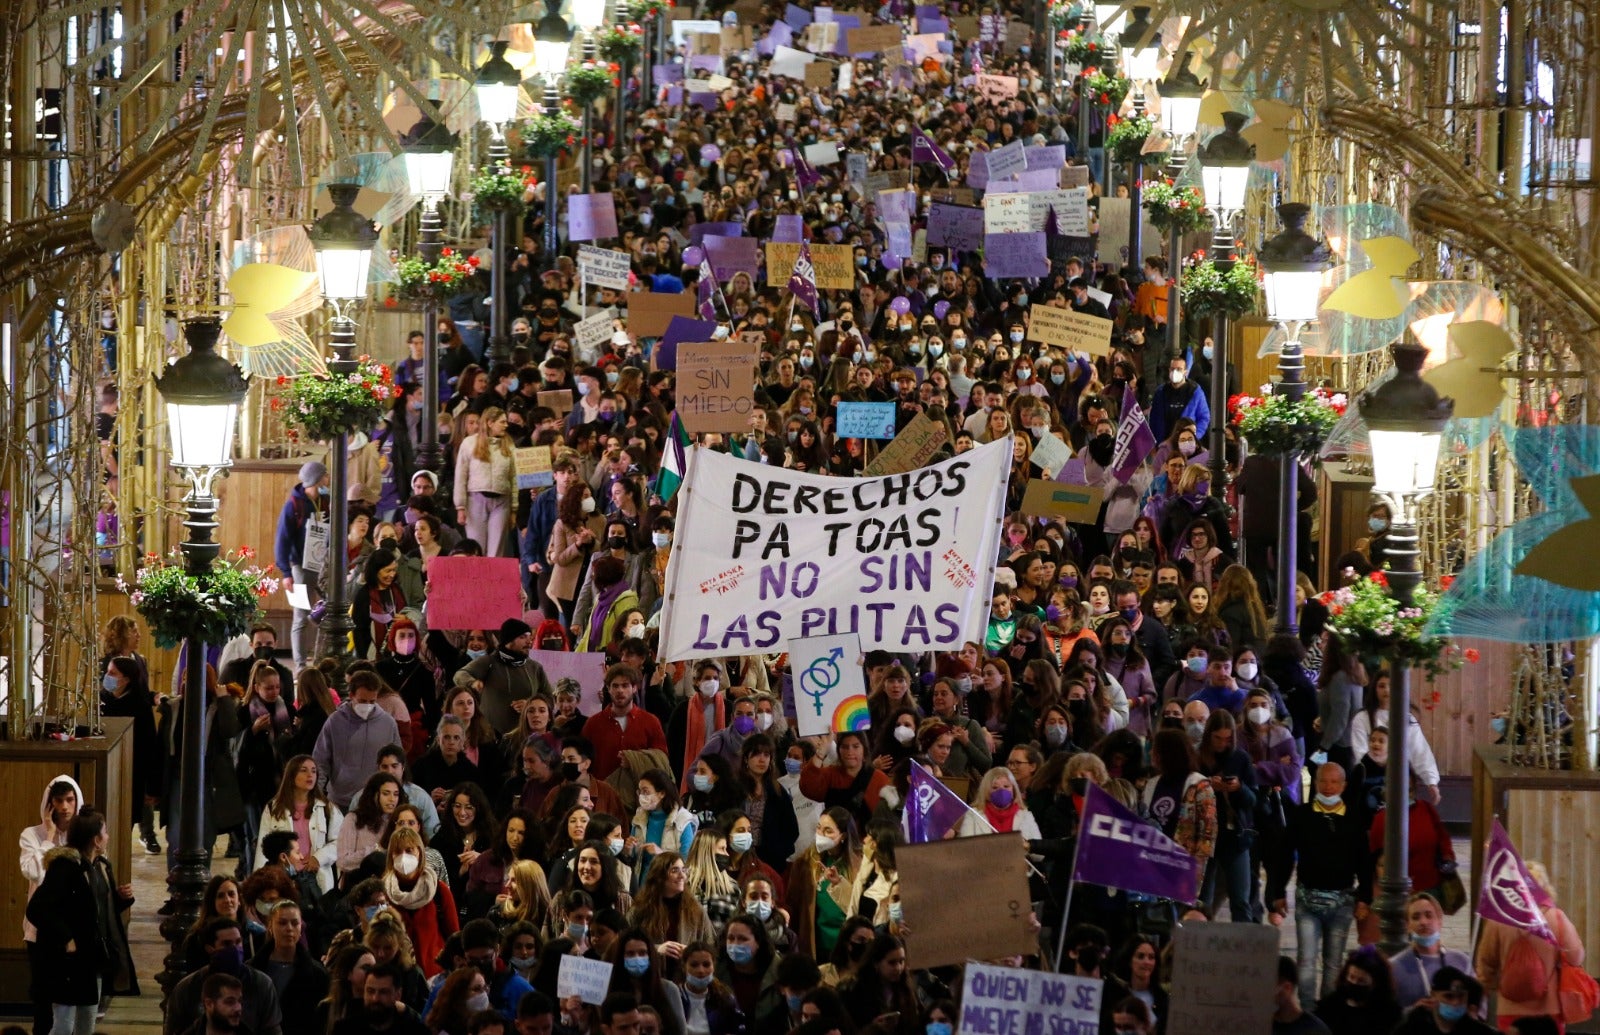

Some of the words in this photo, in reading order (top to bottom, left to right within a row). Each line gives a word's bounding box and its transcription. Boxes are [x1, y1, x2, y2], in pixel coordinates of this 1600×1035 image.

[732, 462, 970, 514] DERECHOS
[732, 520, 790, 559] PA
[759, 561, 822, 601] NO
[859, 551, 932, 594] SIN
[692, 610, 782, 650] LAS
[801, 602, 960, 646] PUTAS
[1040, 979, 1066, 1007] NO
[1072, 984, 1097, 1011] SE
[962, 1004, 1020, 1035] MUEVE
